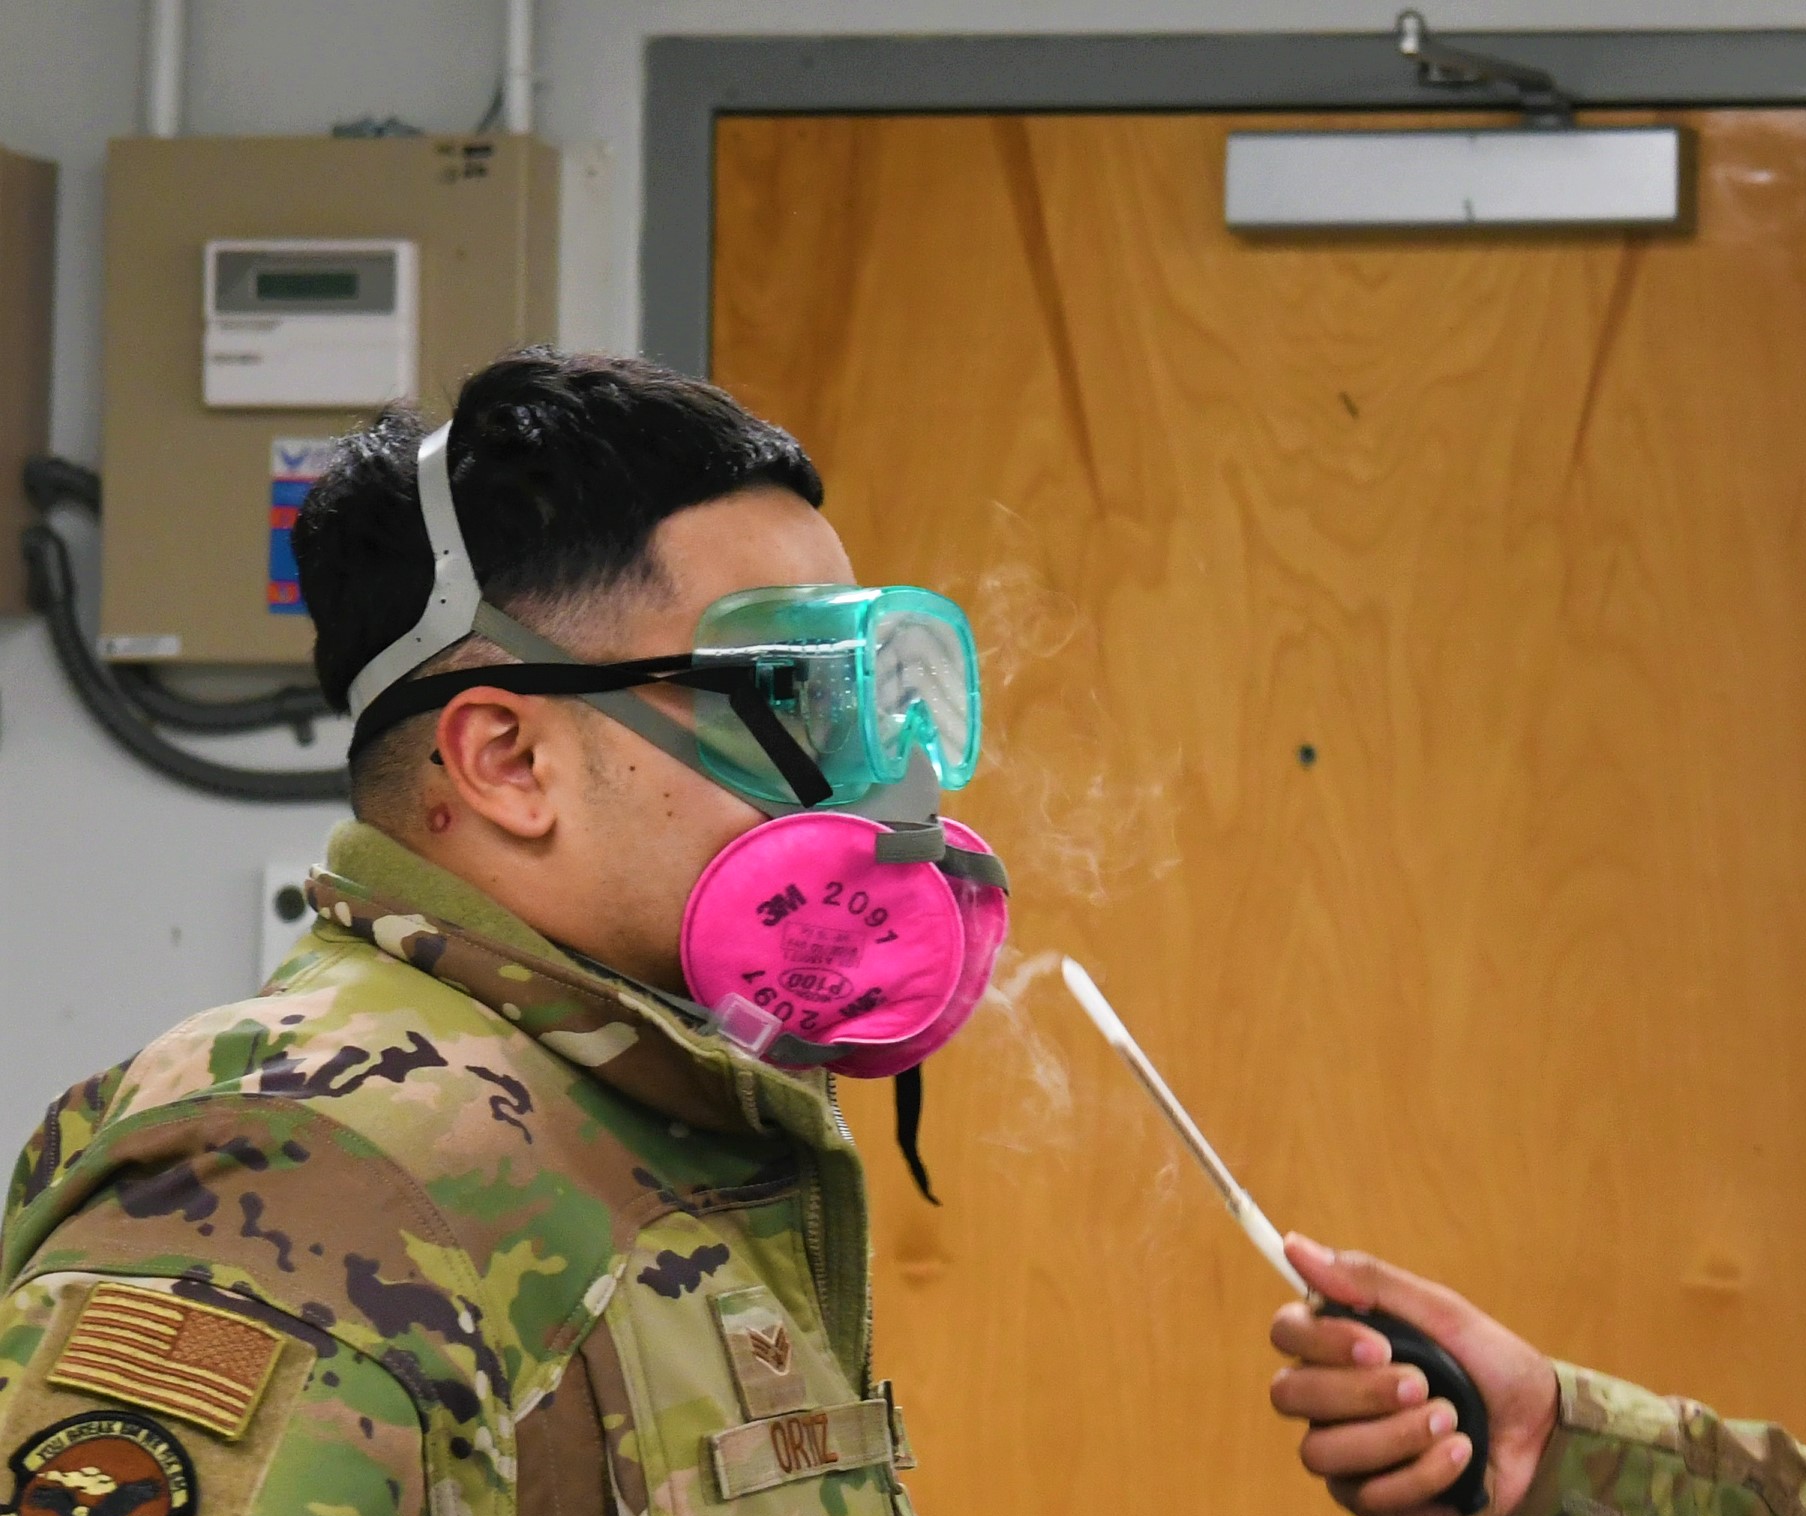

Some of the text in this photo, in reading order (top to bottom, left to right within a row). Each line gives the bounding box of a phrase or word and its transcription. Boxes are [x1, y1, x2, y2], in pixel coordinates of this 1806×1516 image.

[757, 882, 898, 944] 3M 2091
[788, 974, 845, 995] P100
